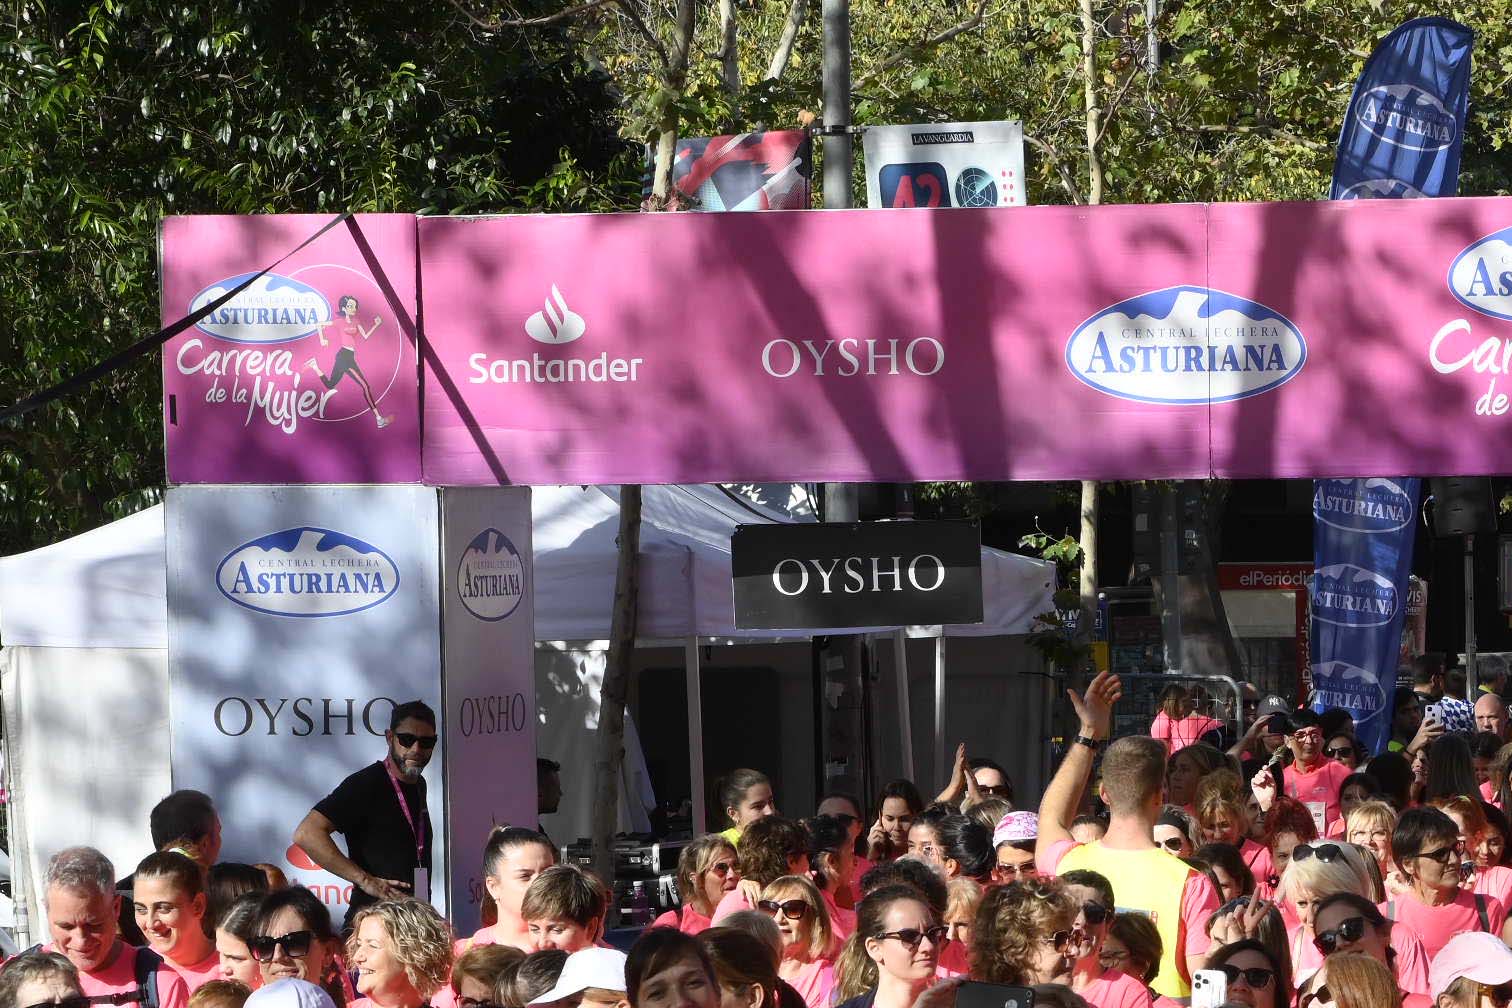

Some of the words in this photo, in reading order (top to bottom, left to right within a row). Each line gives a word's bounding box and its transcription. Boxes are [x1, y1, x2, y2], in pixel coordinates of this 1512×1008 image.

[1362, 98, 1450, 141] ASTURIANA
[200, 299, 319, 325] ASTURIANA
[1084, 321, 1288, 364] ASTURIANA
[1121, 327, 1196, 339] CENTRAL
[1205, 326, 1279, 337] LECHERA
[176, 339, 294, 375] Carrera
[469, 352, 643, 384] Santander
[761, 337, 945, 377] OYSHO
[206, 378, 227, 402] de
[232, 378, 247, 403] la
[245, 372, 338, 434] Mujer
[1475, 377, 1509, 416] de
[1313, 486, 1405, 522] ASTURIANA
[230, 561, 386, 594] ASTURIANA
[259, 558, 316, 568] CENTRAL
[322, 558, 380, 568] LECHERA
[463, 561, 521, 598] ASTURIANA
[772, 555, 946, 596] OYSHO
[213, 697, 400, 737] OYSHO
[460, 693, 526, 737] OYSHO
